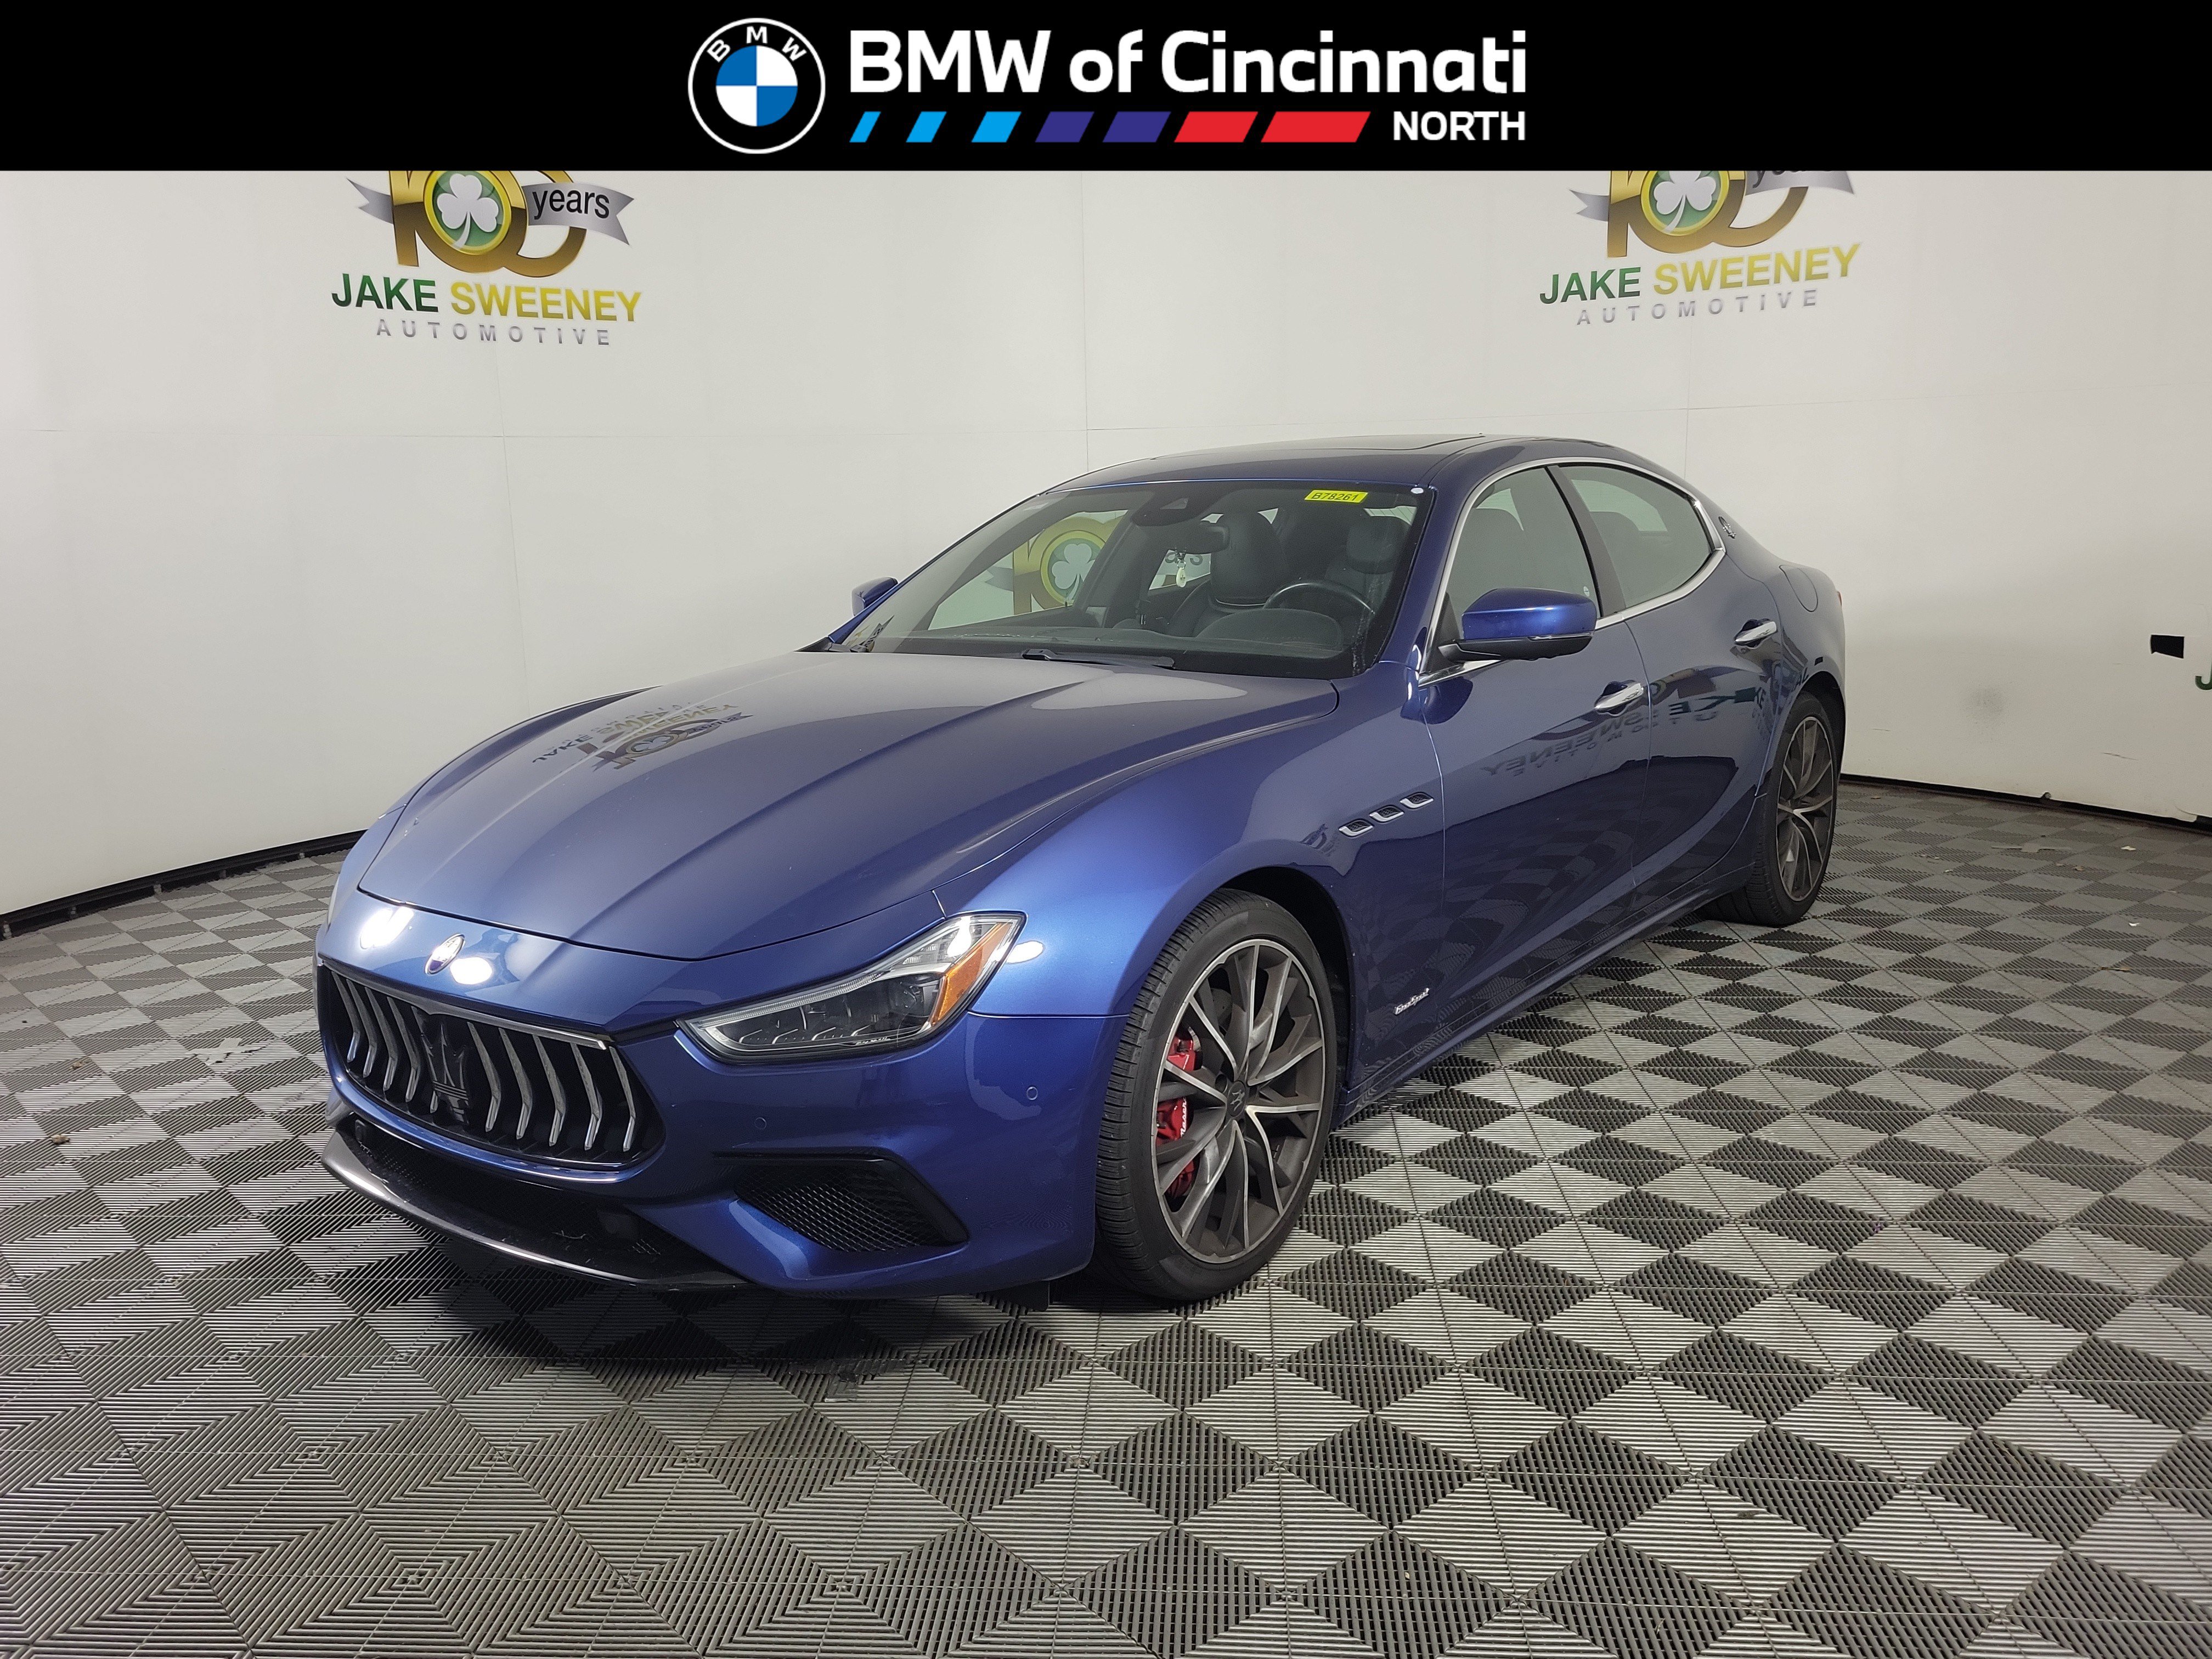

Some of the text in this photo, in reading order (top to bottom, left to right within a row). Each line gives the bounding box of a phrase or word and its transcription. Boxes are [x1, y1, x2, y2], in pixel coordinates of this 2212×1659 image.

[532, 189, 610, 220] years
[1539, 244, 1861, 304] JAKE SWEENEY
[331, 273, 641, 321] JAKE SWEENEY
[1576, 290, 1818, 325] AUTOMOTIVE
[376, 319, 610, 346] AUTOMOTIVE
[1311, 492, 1360, 501] B78261
